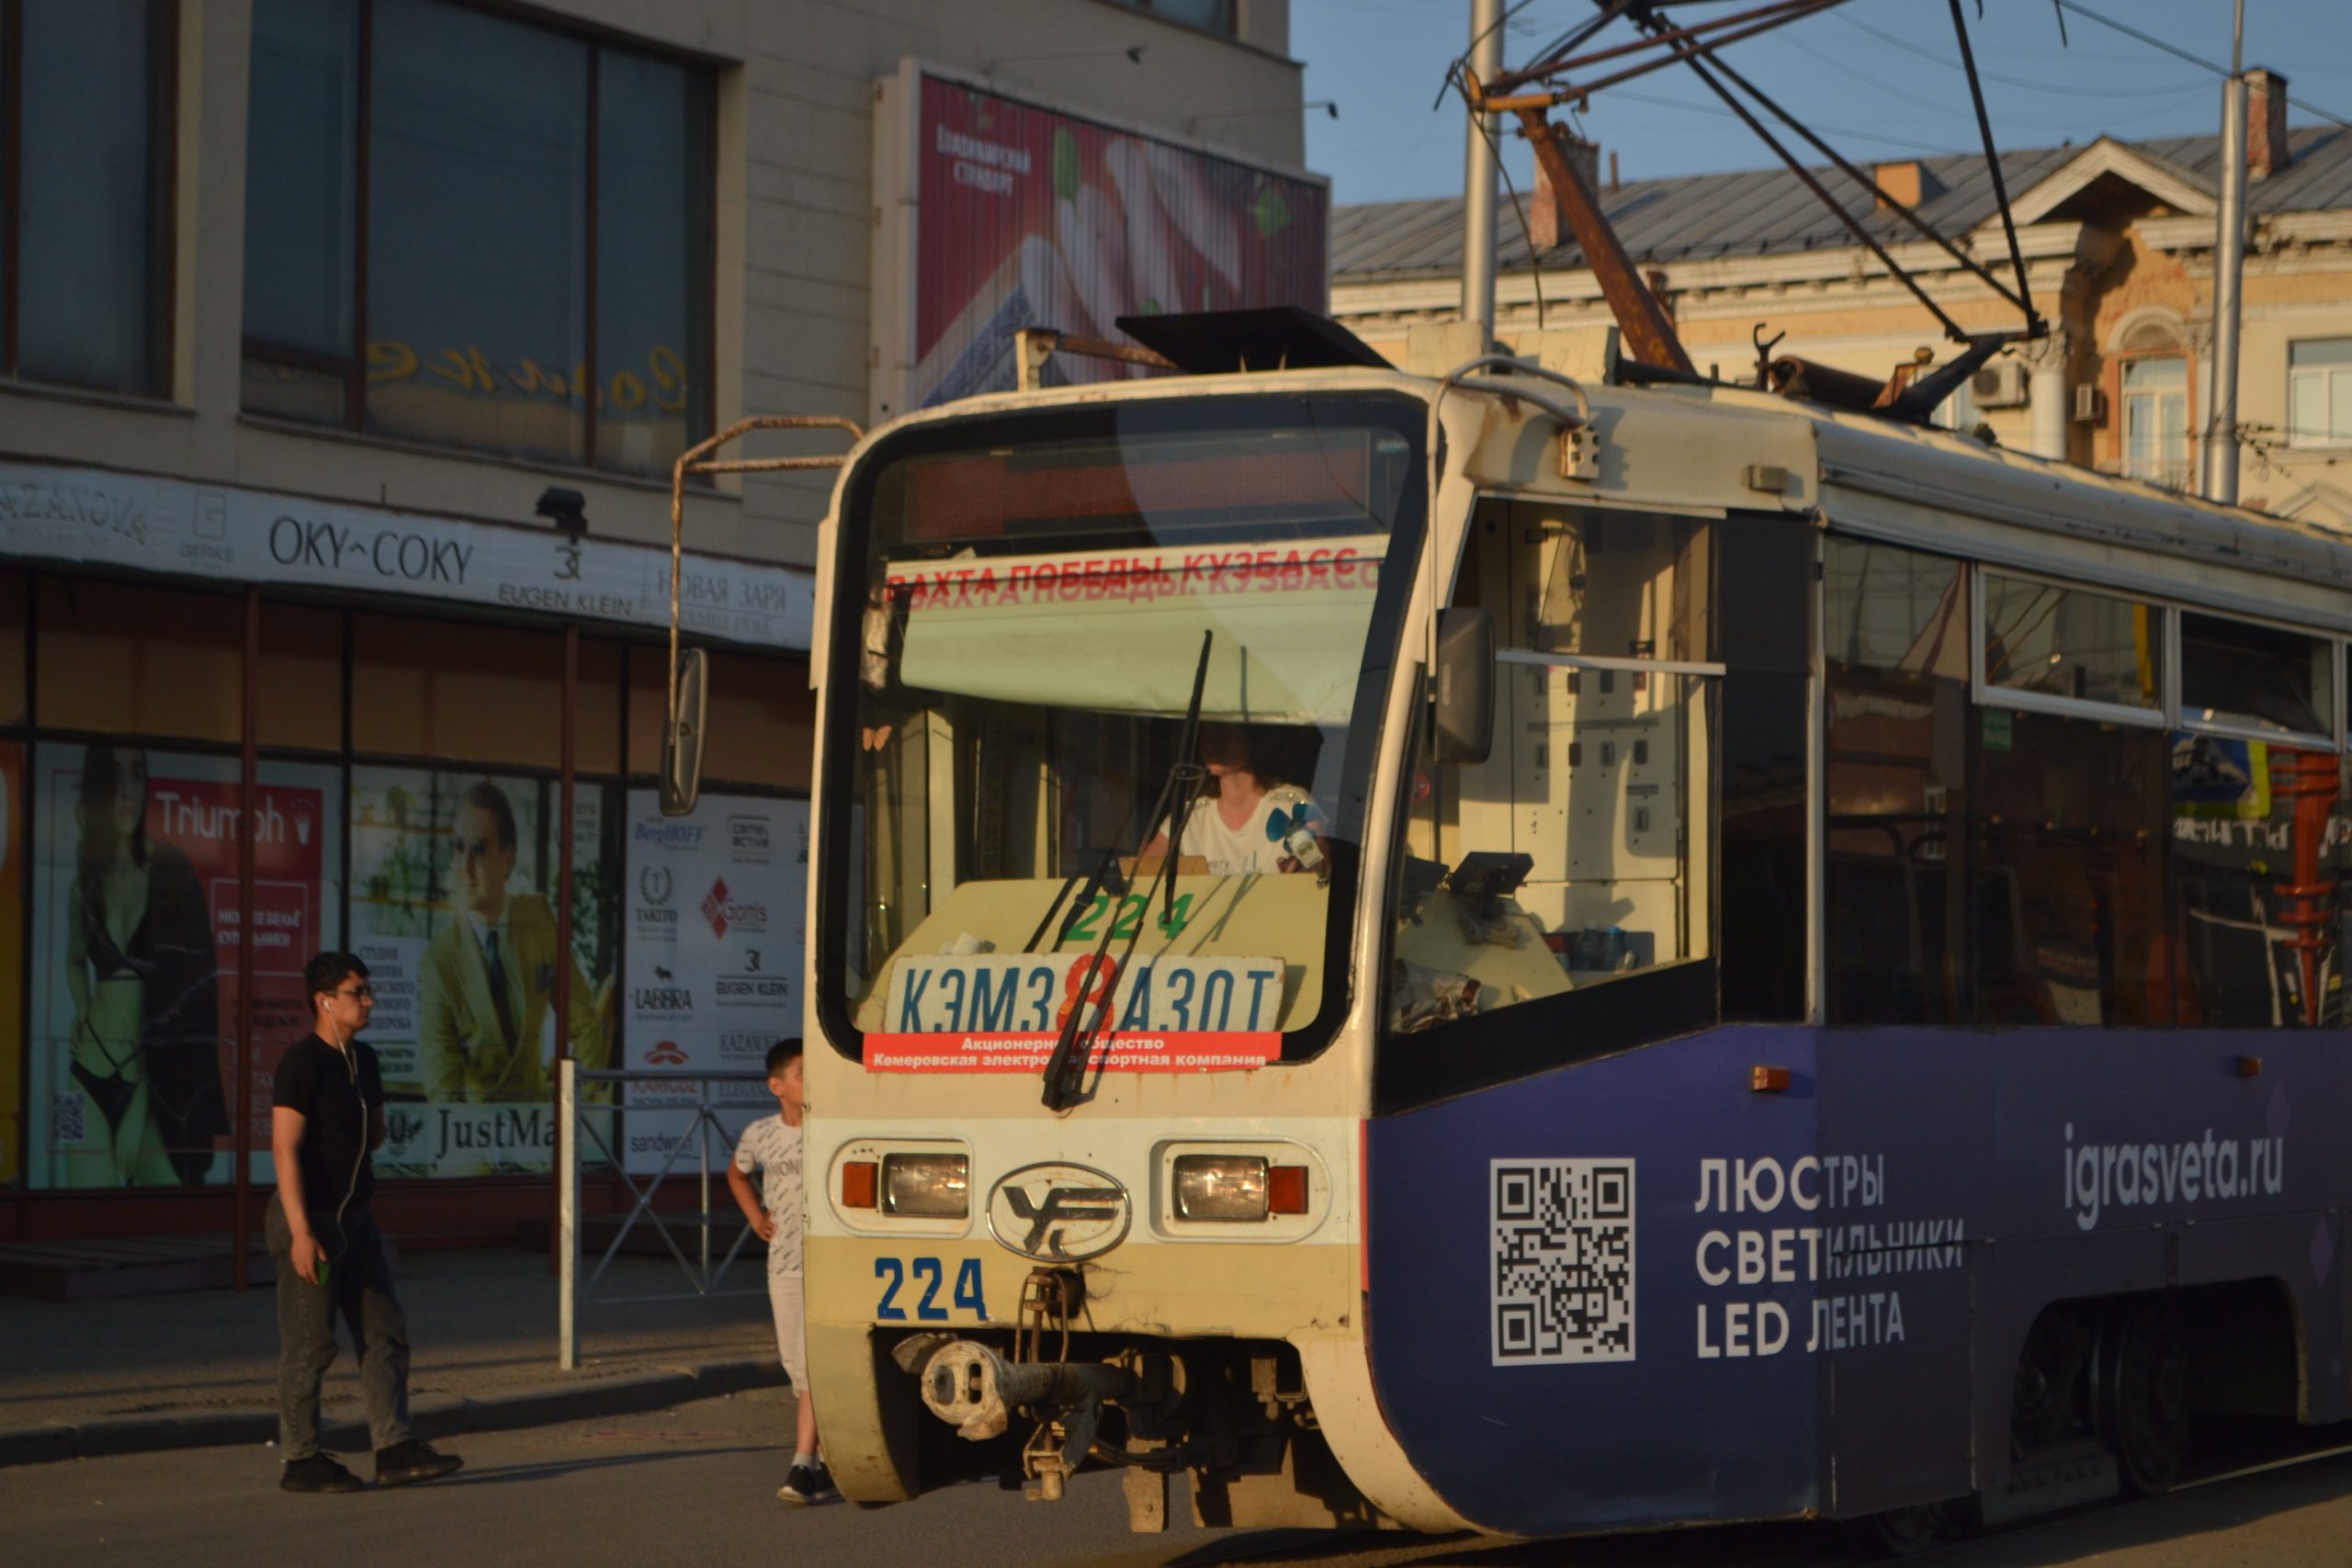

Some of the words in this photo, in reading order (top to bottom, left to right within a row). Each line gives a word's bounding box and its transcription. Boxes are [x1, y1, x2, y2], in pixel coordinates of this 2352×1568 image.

[498, 582, 570, 610] EUGEN
[578, 594, 632, 616] KLEIN
[658, 569, 728, 604] НОВАЯ
[738, 581, 786, 612] ЗАРЯ
[887, 568, 996, 602] ВАХТА
[1182, 548, 1357, 581] КУЗБАСС
[219, 931, 290, 947] КУПЬНИКИ
[1065, 894, 1194, 942] 224
[635, 987, 692, 1010] LABBRA
[901, 967, 1055, 1032] КЭМЗ
[1120, 967, 1274, 1032] АЗОТ
[874, 1054, 977, 1068] Кемеровская
[982, 1054, 1170, 1068] электроаспортная
[1175, 1054, 1265, 1066] компания
[962, 1037, 1061, 1054] Акционерн
[1079, 1036, 1164, 1054] общество
[437, 1109, 555, 1159] JustMa
[1695, 1154, 1884, 1213] ЛЮСТРЫ
[2064, 1122, 2284, 1231] igrasveta.ru
[1696, 1218, 1964, 1286] СВЕТИЛЬНИКИ
[875, 1258, 987, 1320] 224
[1697, 1301, 1791, 1358] LED
[1806, 1292, 1905, 1353] ЛЕНТА
